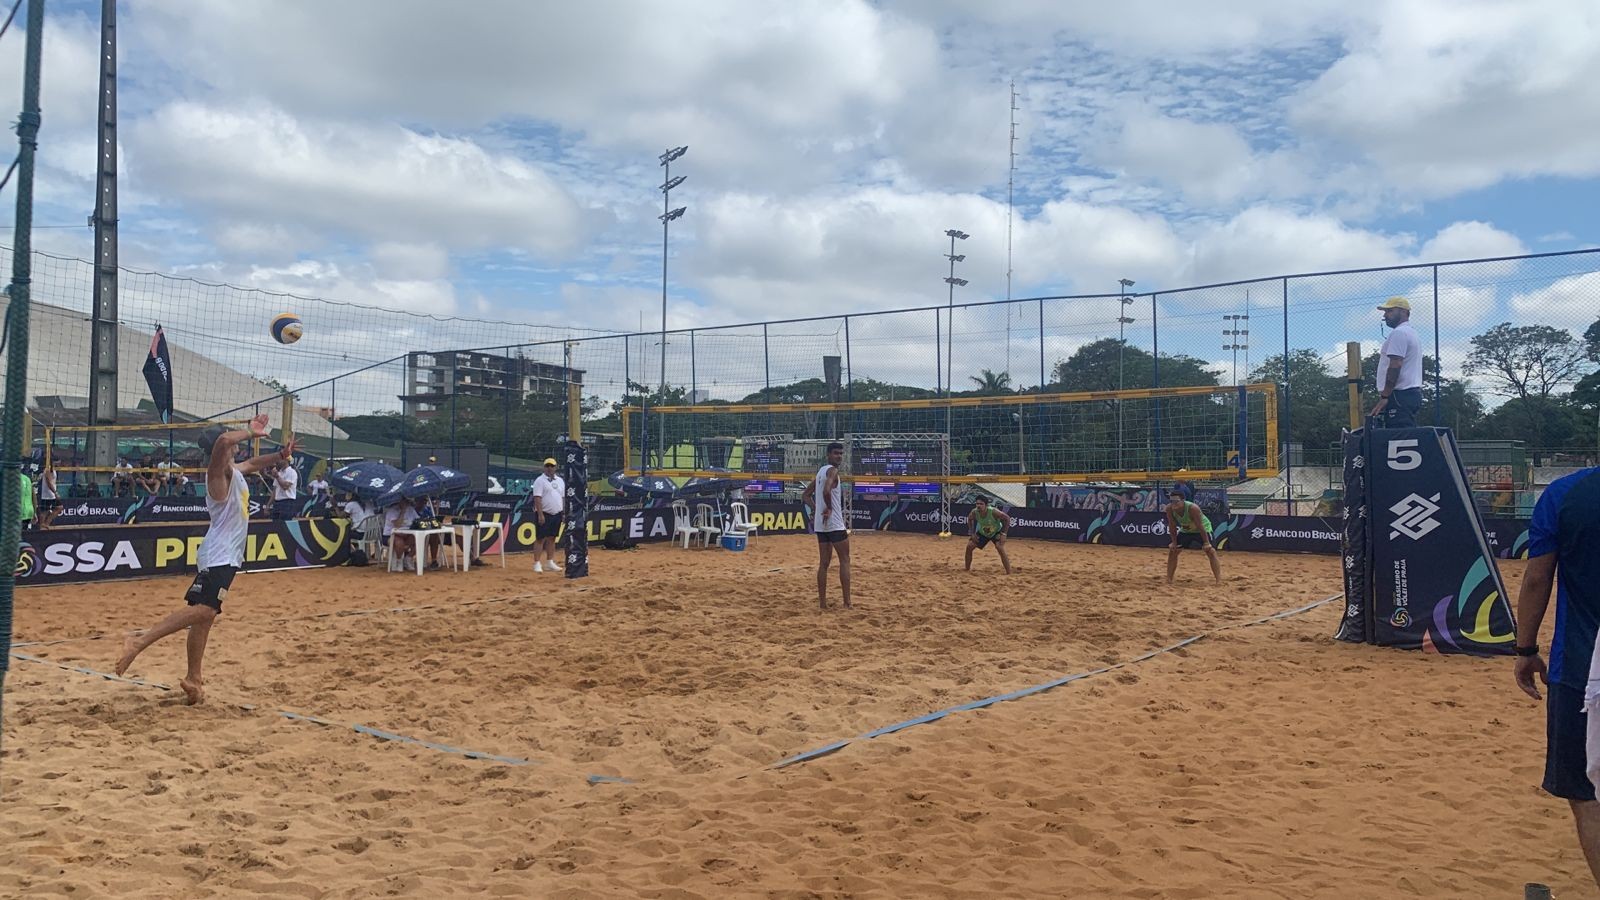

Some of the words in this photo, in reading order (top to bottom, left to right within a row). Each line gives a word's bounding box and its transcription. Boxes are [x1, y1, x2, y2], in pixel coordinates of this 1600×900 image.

[1387, 439, 1422, 471] 5
[89, 507, 120, 516] BRASIL
[629, 512, 644, 538] É
[649, 516, 668, 537] A
[750, 512, 806, 531] PRAIA
[1018, 518, 1043, 527] BANCO
[1054, 520, 1081, 530] BRASIL
[1120, 522, 1151, 534] VÔLEI
[1265, 528, 1297, 539] BANCO
[1298, 531, 1311, 539] DO
[1394, 560, 1400, 569] DE
[1394, 569, 1402, 607] BRASILEIRO
